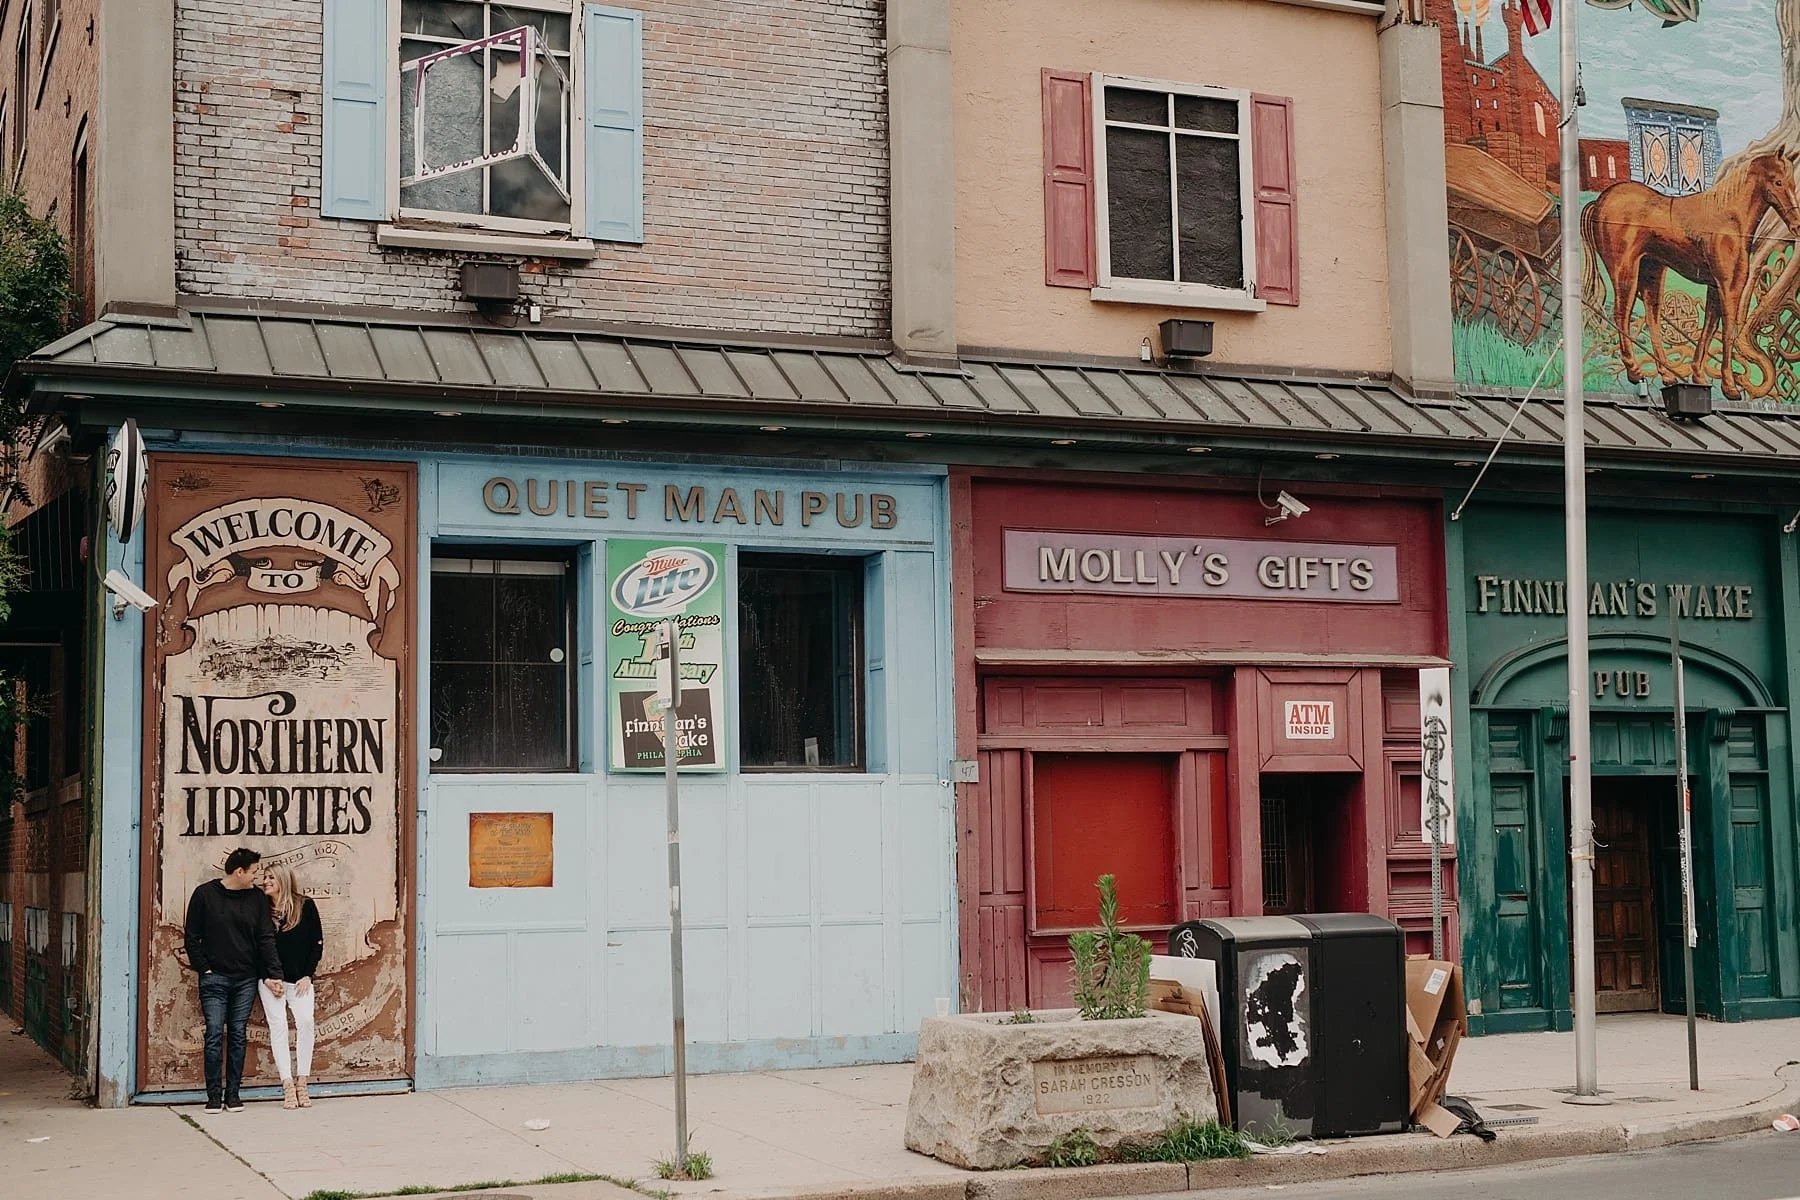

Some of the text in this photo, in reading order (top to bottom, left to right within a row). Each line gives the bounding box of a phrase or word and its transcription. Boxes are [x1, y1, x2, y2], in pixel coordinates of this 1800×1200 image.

[482, 476, 899, 530] QUIET MAN PUB
[184, 508, 378, 567] WELCOME
[642, 556, 689, 576] Miller
[1038, 544, 1374, 591] MOLLY'S GIFTS
[261, 572, 304, 589] TO
[630, 566, 701, 610] Lite
[1477, 574, 1753, 618] FINNIAN'S WAKE
[612, 614, 721, 637] Congralations
[613, 658, 717, 684] Annisary
[1594, 671, 1650, 697] PUB
[624, 714, 708, 738] finnian's
[1289, 704, 1331, 725] ATM
[173, 691, 388, 774] NORTHERN
[1290, 725, 1329, 735] INSIDE
[636, 749, 703, 760] PHILALPHIA
[179, 786, 373, 837] LIBERTIES
[1069, 1061, 1119, 1075] MEMORY
[1040, 1074, 1151, 1094] SARAH CRESSON
